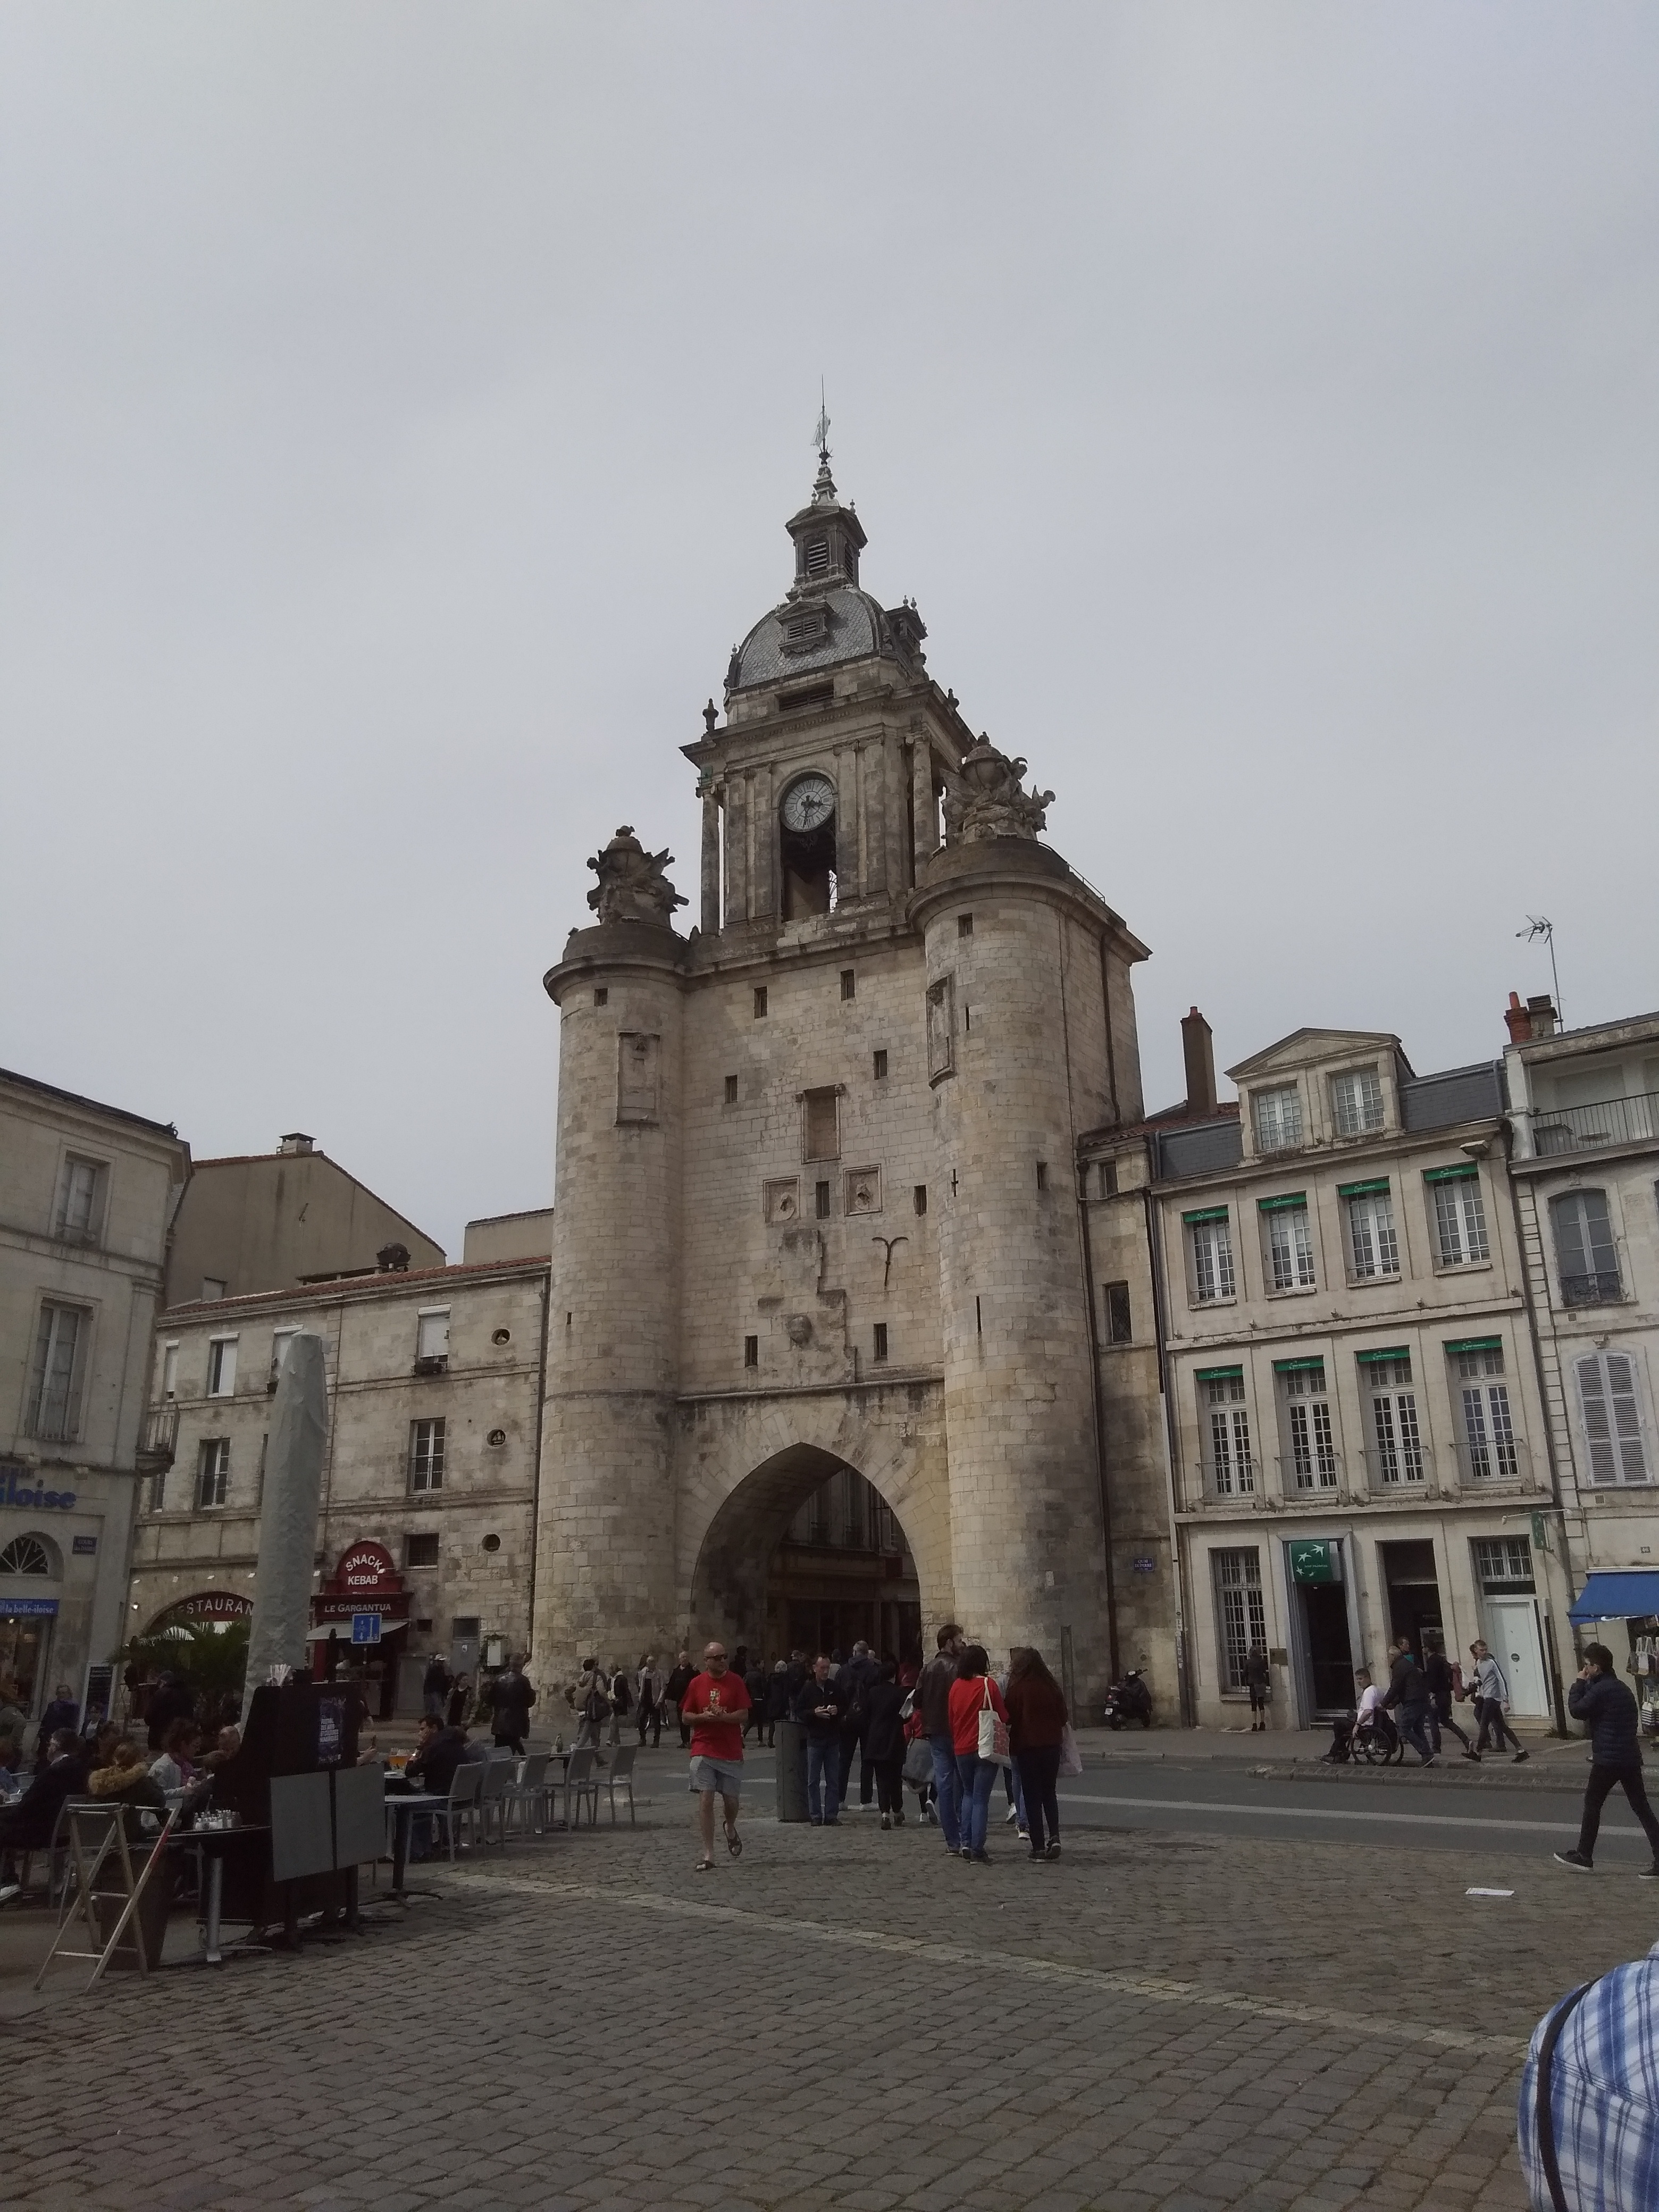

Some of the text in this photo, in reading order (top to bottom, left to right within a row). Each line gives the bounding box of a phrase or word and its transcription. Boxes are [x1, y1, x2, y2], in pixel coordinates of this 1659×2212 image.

[346, 1554, 383, 1571] SNACK
[348, 1575, 378, 1586] KEBAB
[167, 1598, 253, 1620] RESTAURAN
[338, 1604, 391, 1613] GARGANTUA
